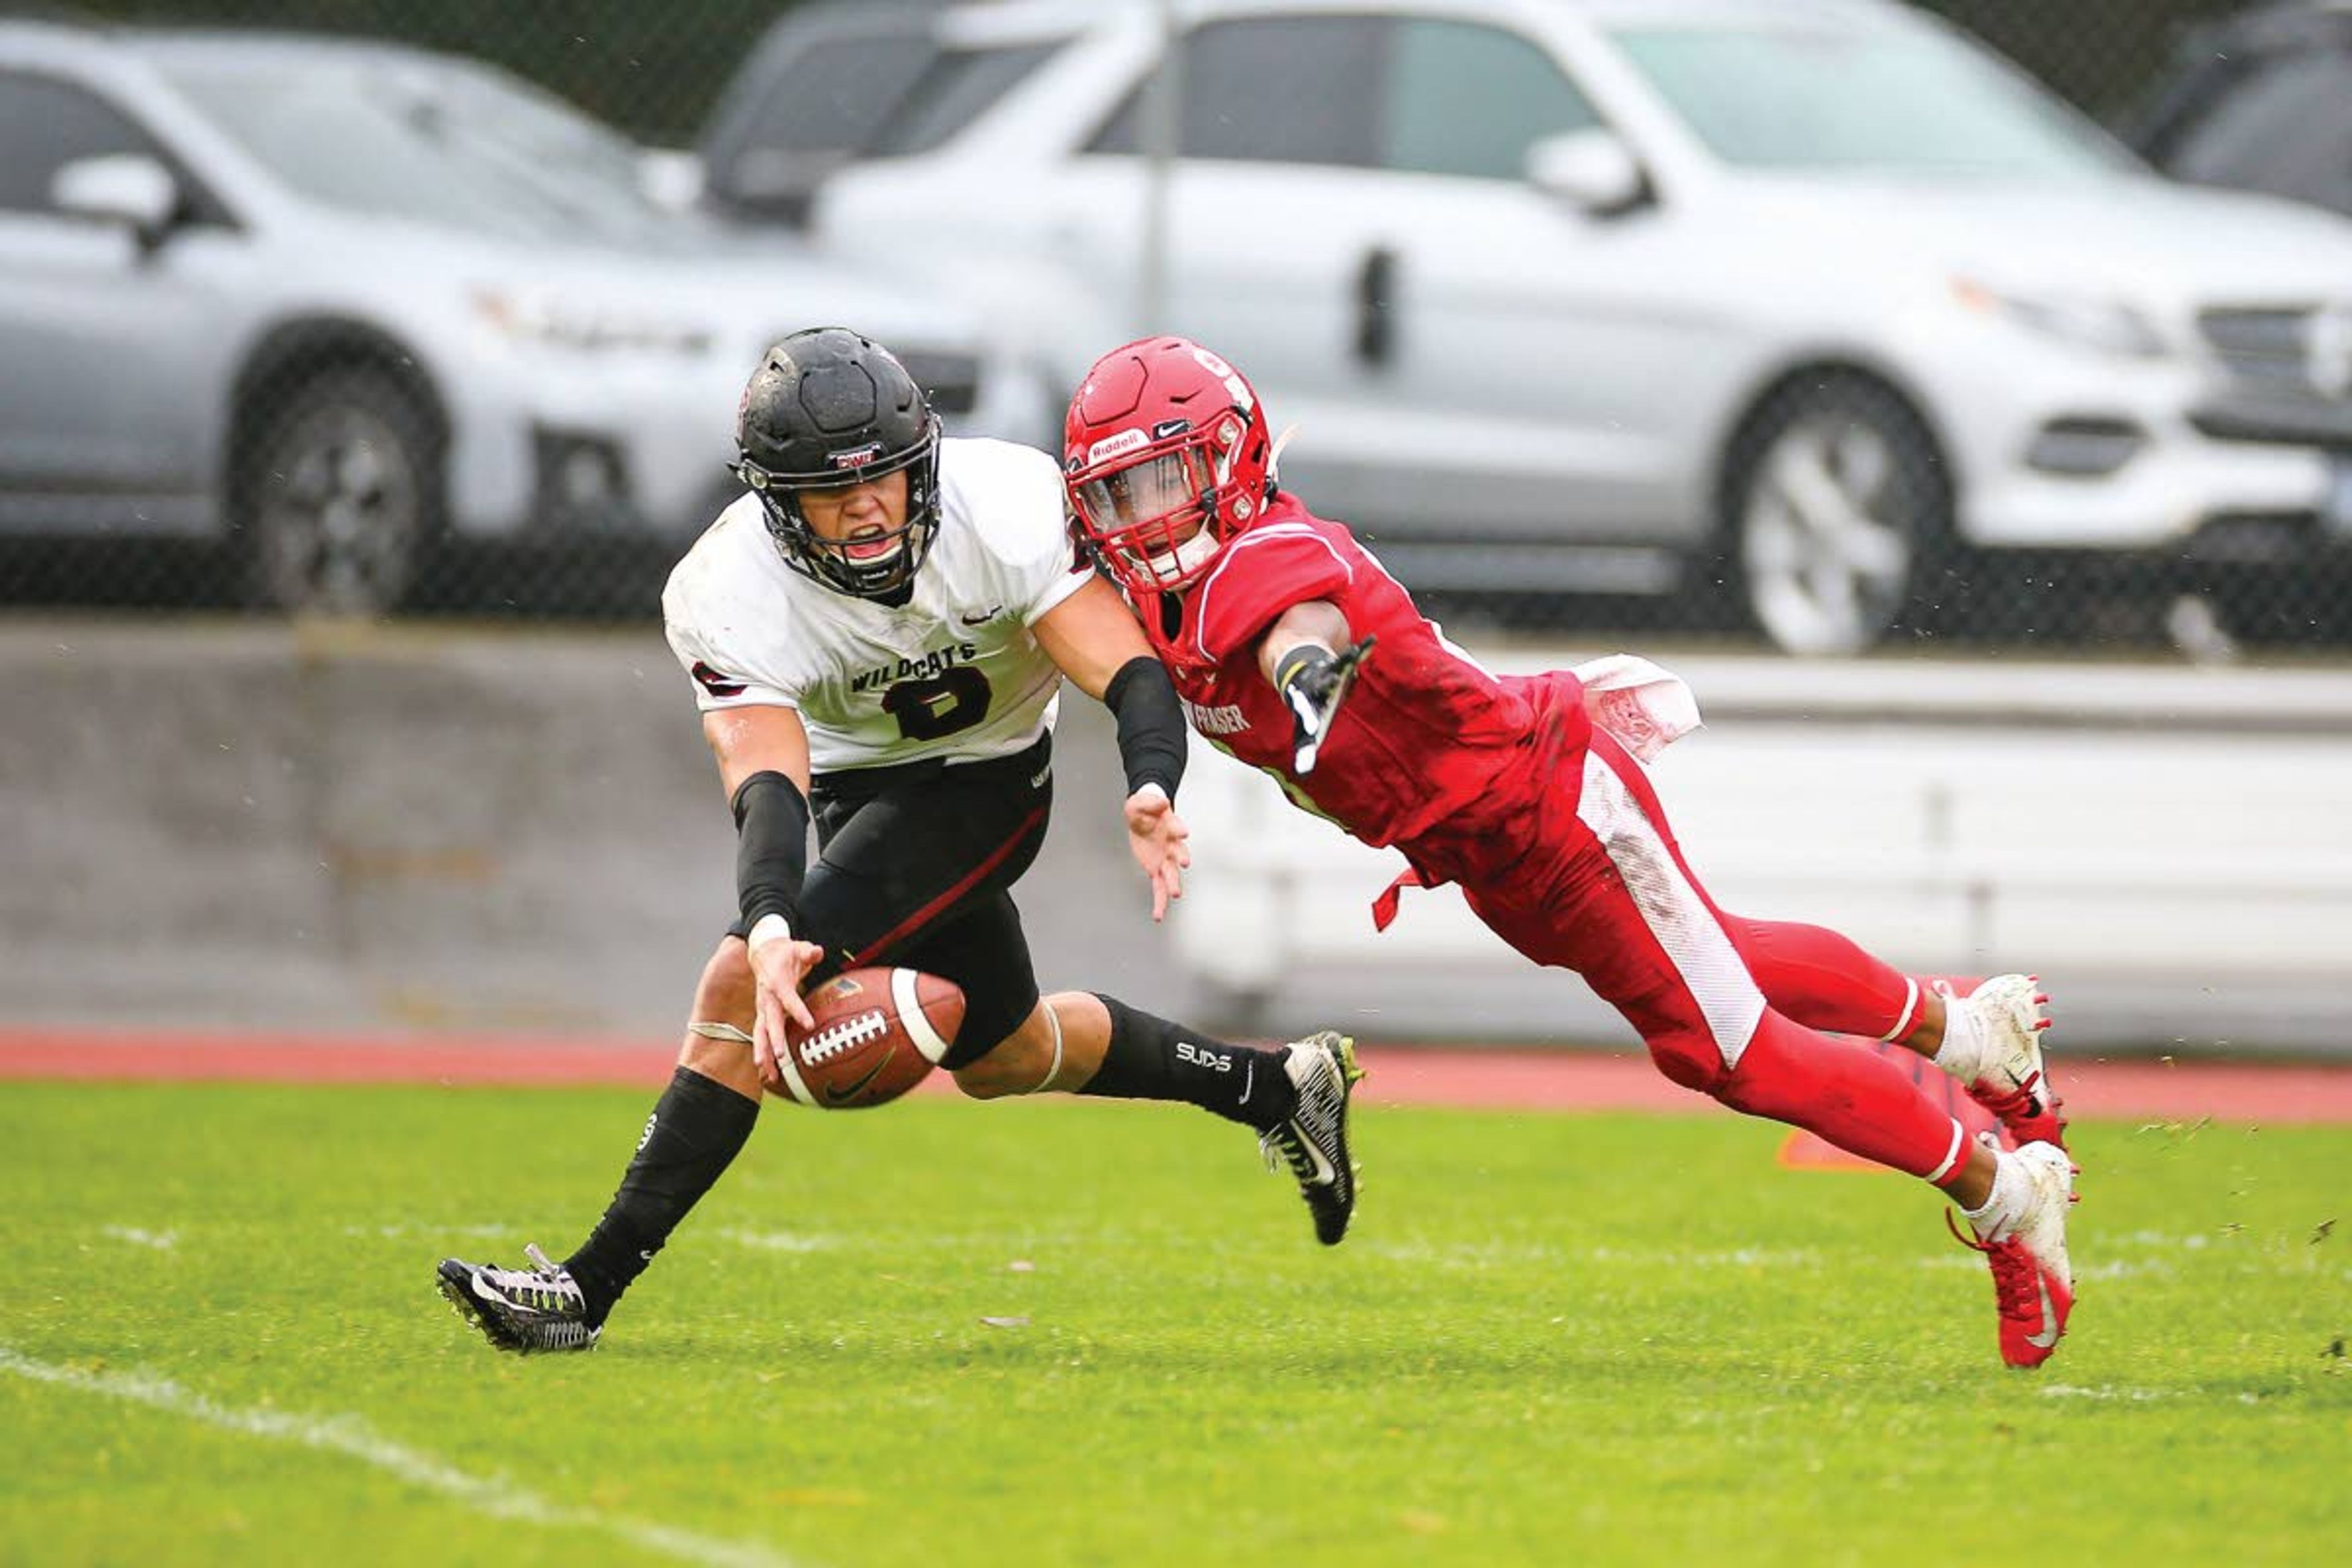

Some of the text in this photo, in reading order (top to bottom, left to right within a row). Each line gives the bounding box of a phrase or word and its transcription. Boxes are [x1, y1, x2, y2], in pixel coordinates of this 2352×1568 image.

[1093, 432, 1138, 457] Riddell
[851, 643, 976, 693] WILDCATS
[1194, 704, 1251, 734] FRASER
